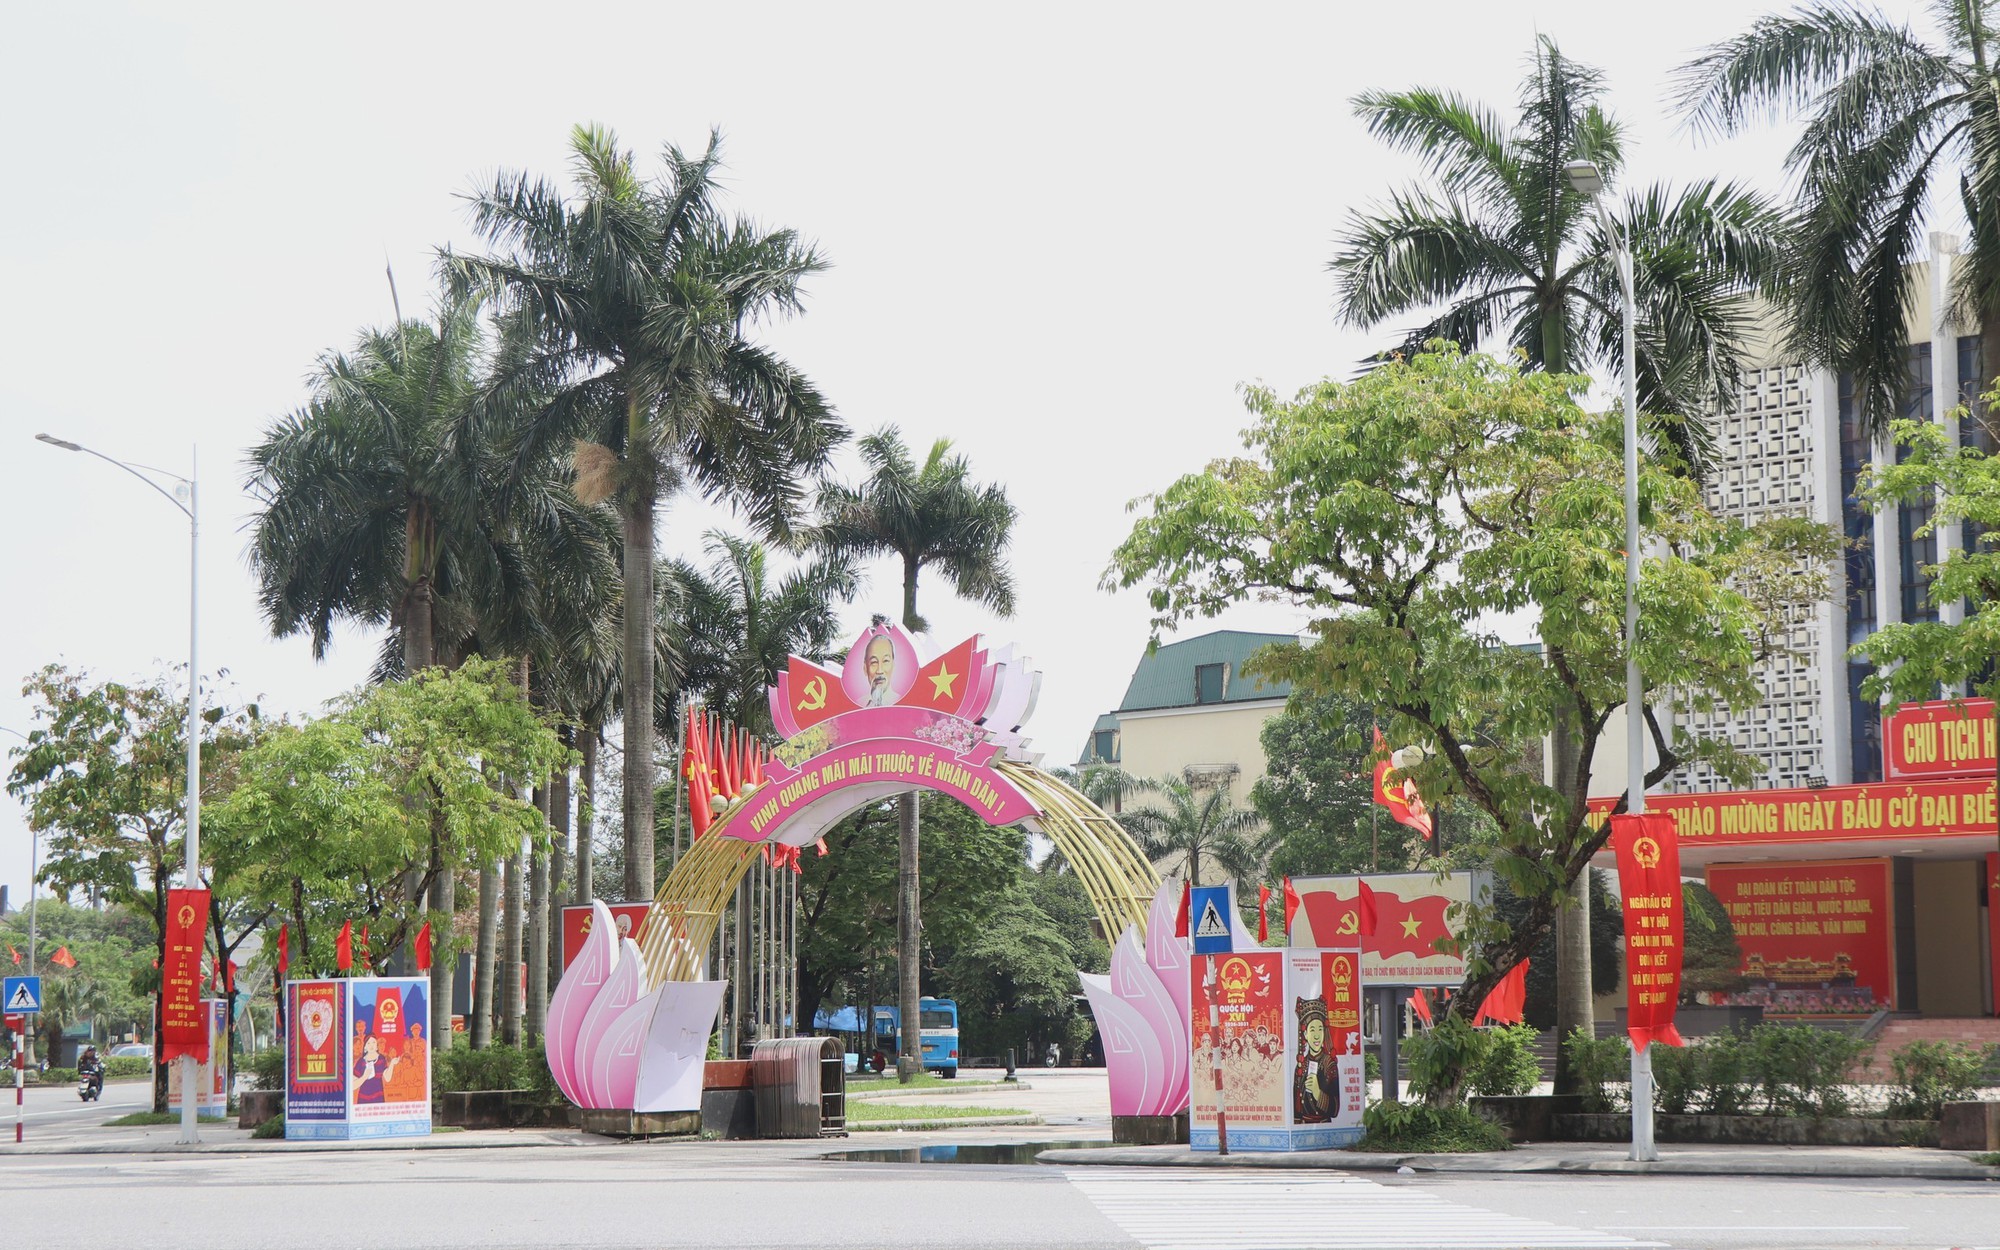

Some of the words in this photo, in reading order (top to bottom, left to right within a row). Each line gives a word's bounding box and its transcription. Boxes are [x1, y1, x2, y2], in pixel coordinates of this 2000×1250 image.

[1903, 712, 1937, 764] CHỦ
[1940, 719, 1980, 768] TỊCH
[750, 798, 780, 833] VINH
[780, 771, 820, 807] QUANG
[822, 759, 846, 785] MÃI
[848, 752, 872, 777] MÃI
[876, 750, 914, 777] THUỘC
[918, 752, 935, 776] VỀ
[934, 764, 972, 790] NHÂN
[970, 776, 998, 810] DÂN
[1667, 801, 1715, 836] CHÀO
[1721, 798, 1778, 834] MỪNG
[1783, 795, 1836, 832] NGÀY
[1842, 788, 1882, 830] BẦU
[1888, 786, 1918, 828] CỬ
[1921, 794, 1956, 832] ĐẠI
[1737, 882, 1752, 899] ĐẠI
[1753, 878, 1776, 895] ĐOÀN
[1777, 876, 1793, 895] KẾT
[1795, 878, 1817, 894] TOÀN
[1819, 877, 1837, 894] DÂN
[1839, 876, 1856, 896] TỘC
[1661, 893, 1672, 908] CỬ
[1733, 902, 1752, 918] MỤC
[1753, 899, 1772, 915] TIÊU
[1773, 899, 1791, 915] DÂN
[1792, 898, 1816, 916] GIÀU,
[1817, 897, 1842, 914] NƯỚC
[1844, 899, 1872, 916] MẠNH,
[1656, 913, 1669, 929] HỘI
[1749, 918, 1768, 937] CHỦ,
[1770, 919, 1793, 935] CÔNG
[1795, 916, 1822, 936] BẰNG,
[1823, 918, 1840, 934] VĂN
[1842, 920, 1866, 933] MINH
[1631, 932, 1645, 947] CỦA
[1661, 935, 1674, 947] TIN,
[1654, 950, 1667, 966] KẾT
[1632, 971, 1642, 985] VÀ
[1656, 972, 1674, 987] VỌNG
[1335, 992, 1349, 1002] XVI
[1220, 1003, 1239, 1013] QUỐC
[1241, 1003, 1254, 1014] HỘI
[1229, 1013, 1245, 1021] XVI
[307, 1060, 326, 1072] XVI
